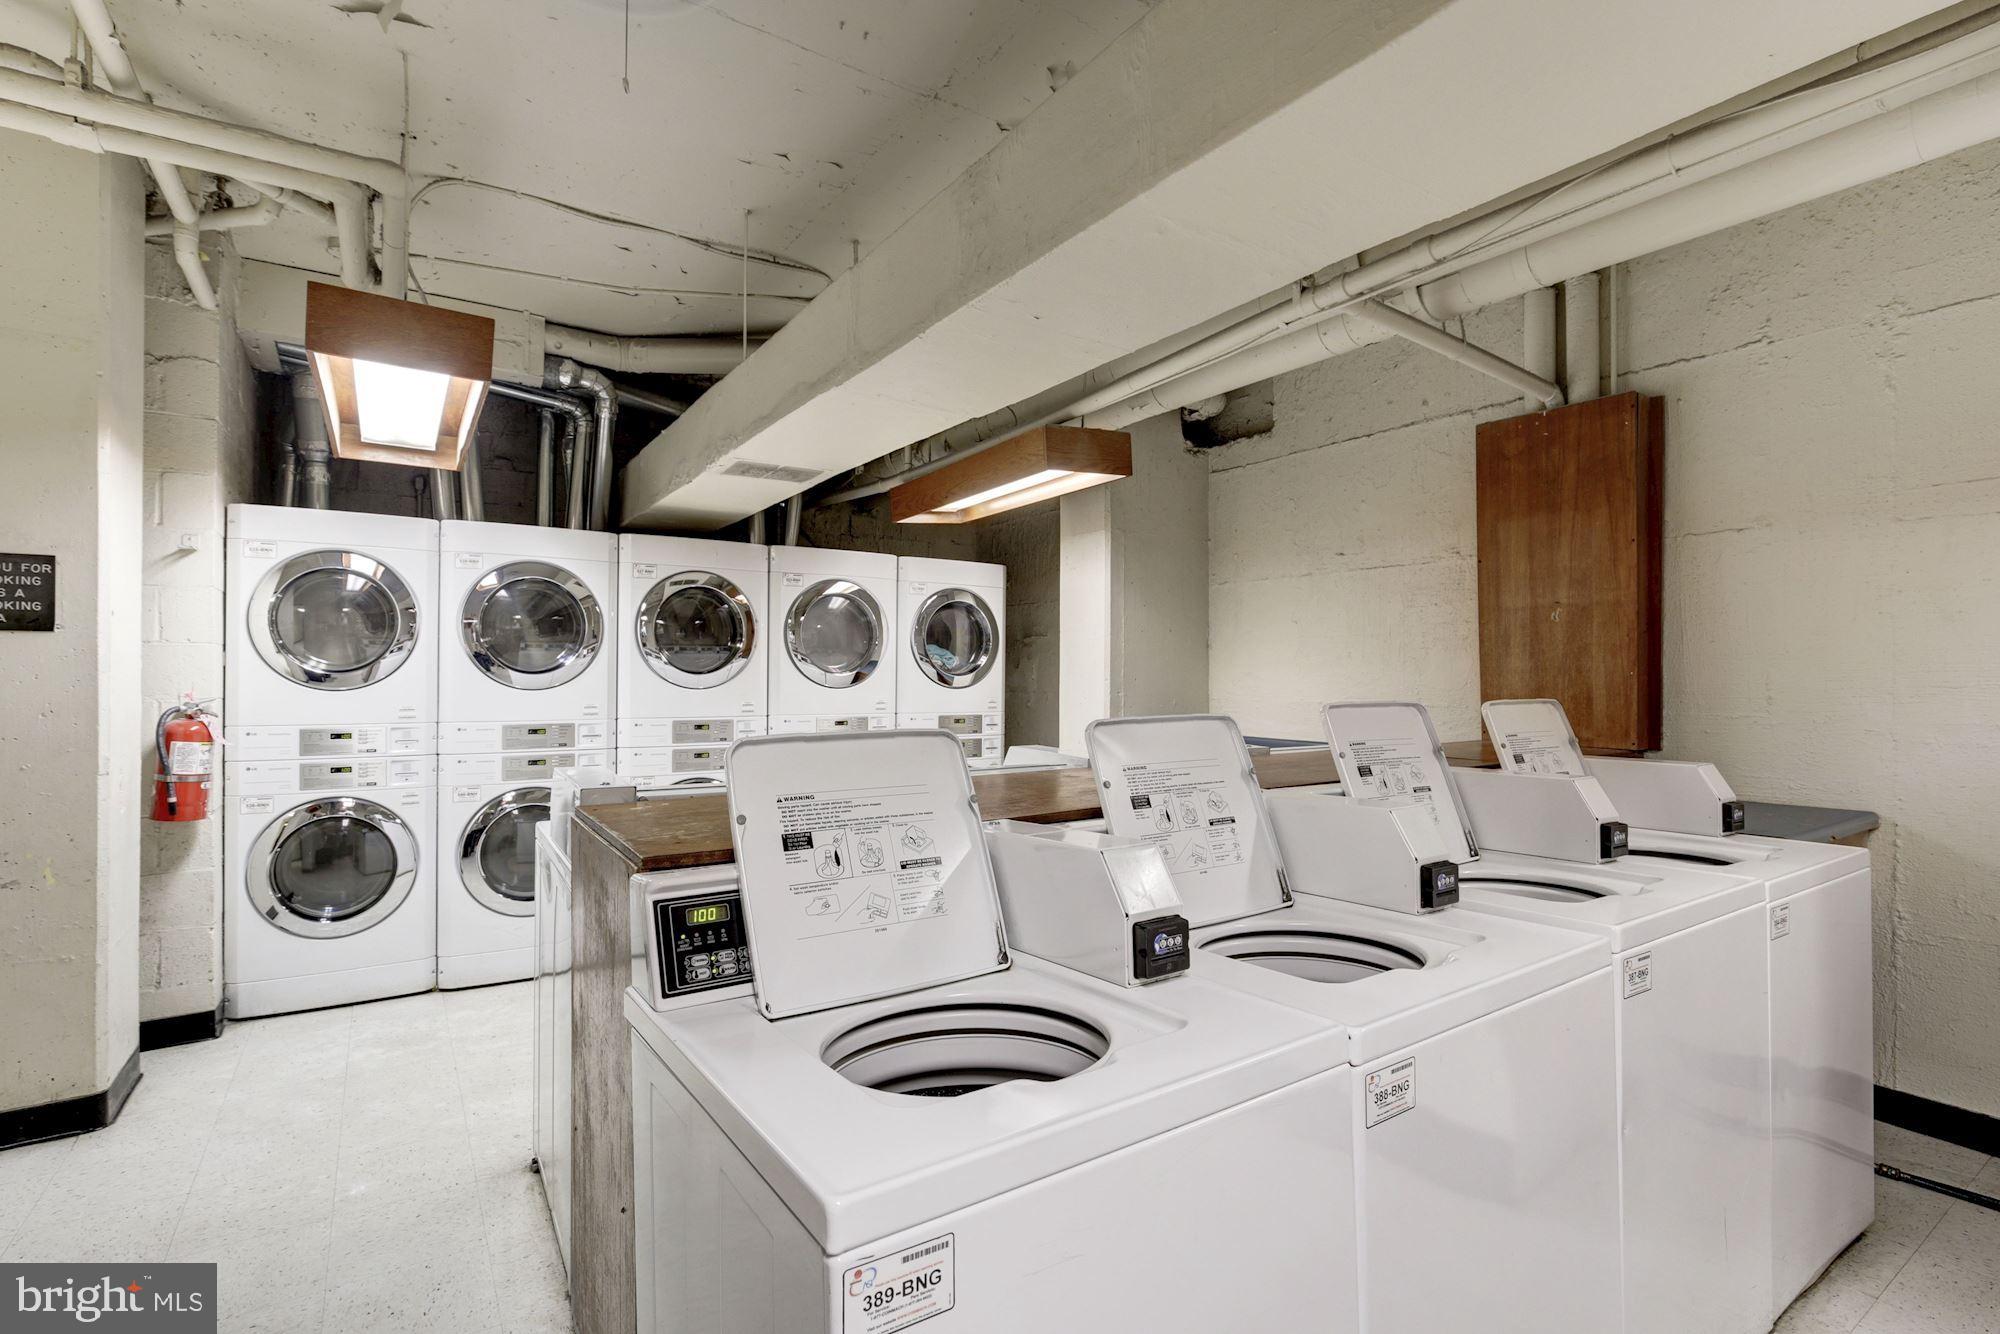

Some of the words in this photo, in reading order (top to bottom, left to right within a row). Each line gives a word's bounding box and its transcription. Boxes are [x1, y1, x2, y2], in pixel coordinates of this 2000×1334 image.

[0, 562, 12, 572] U
[21, 563, 52, 573] FOR
[14, 588, 25, 598] A
[693, 907, 716, 923] 100
[1374, 1079, 1409, 1104] 388-BNG
[863, 1268, 942, 1312] 389-BNG
